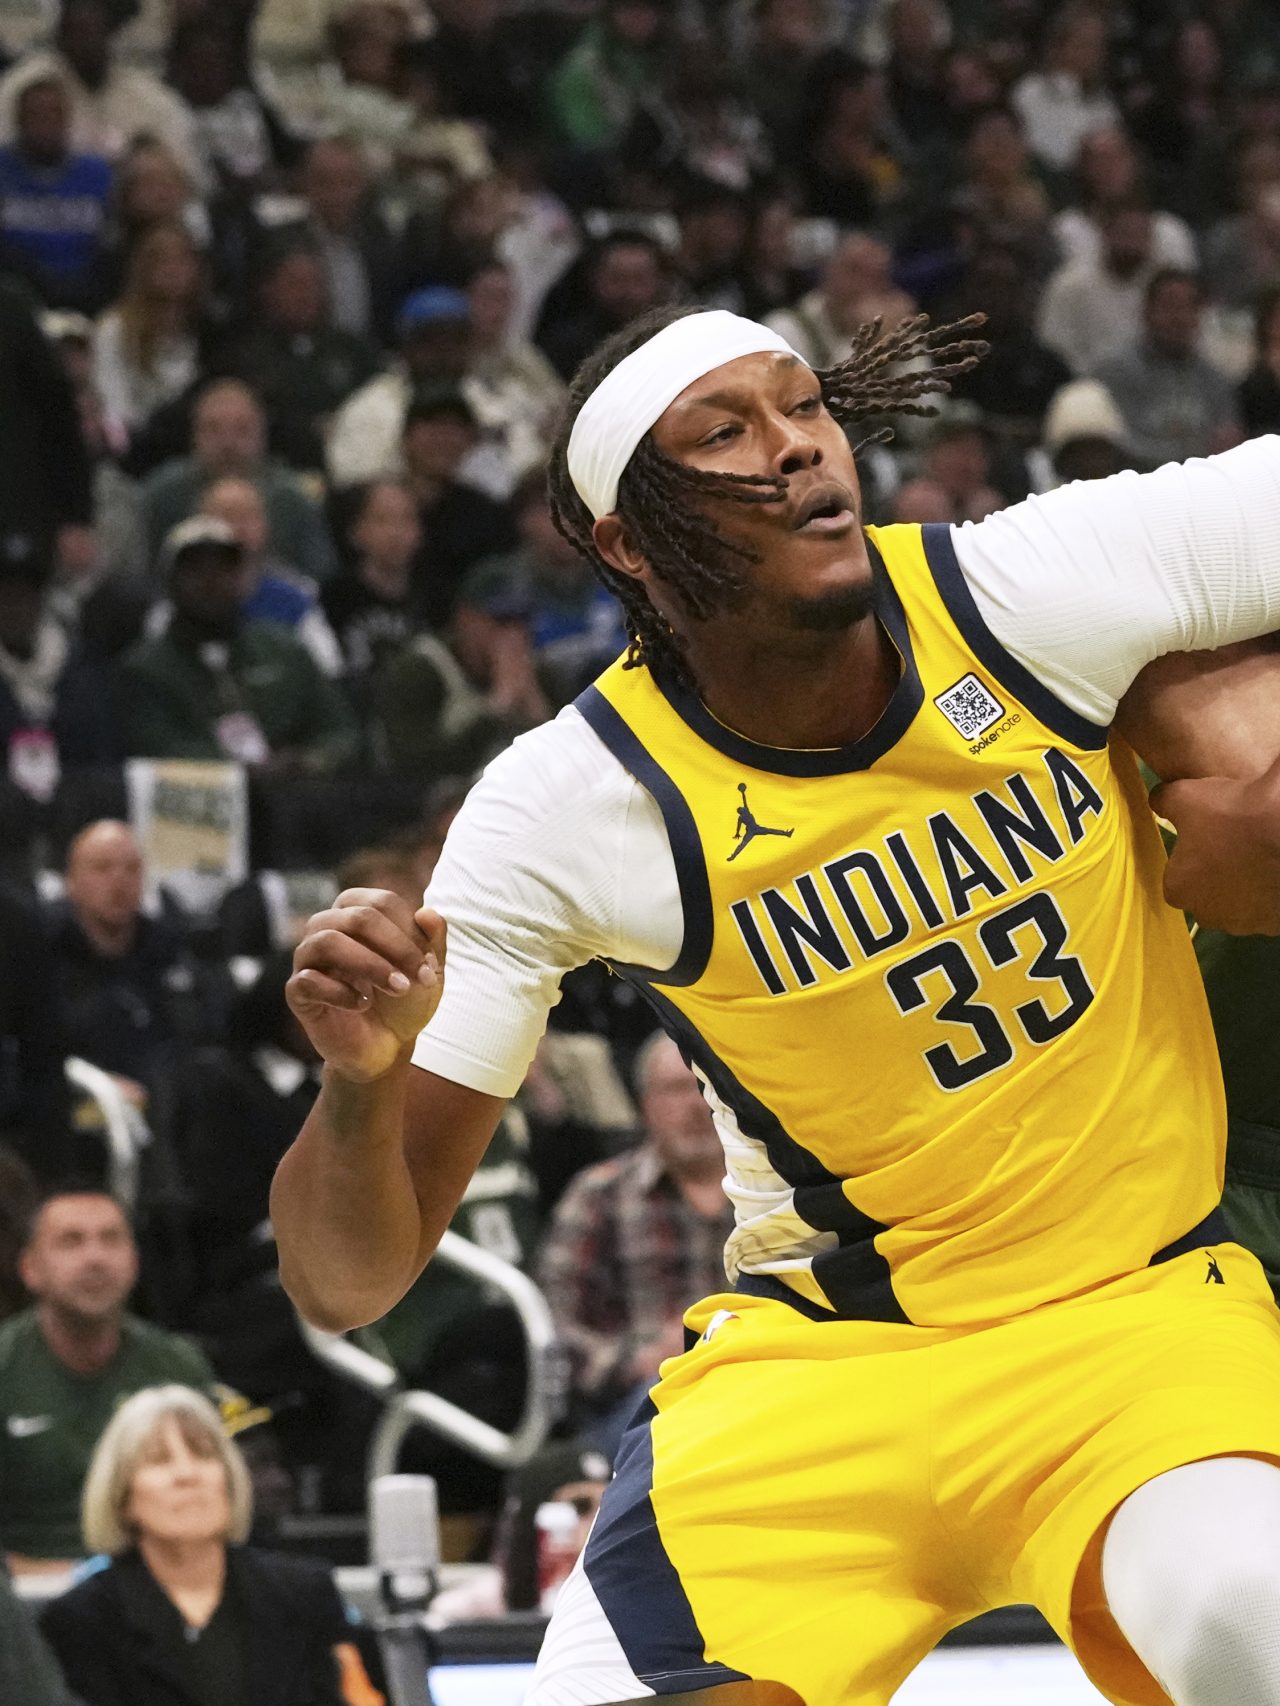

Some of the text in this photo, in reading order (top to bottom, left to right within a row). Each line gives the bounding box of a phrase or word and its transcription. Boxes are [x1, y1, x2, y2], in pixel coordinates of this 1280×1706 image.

[968, 713, 1022, 755] spokenote
[729, 746, 1104, 997] INDIANA
[885, 888, 1097, 1093] 33
